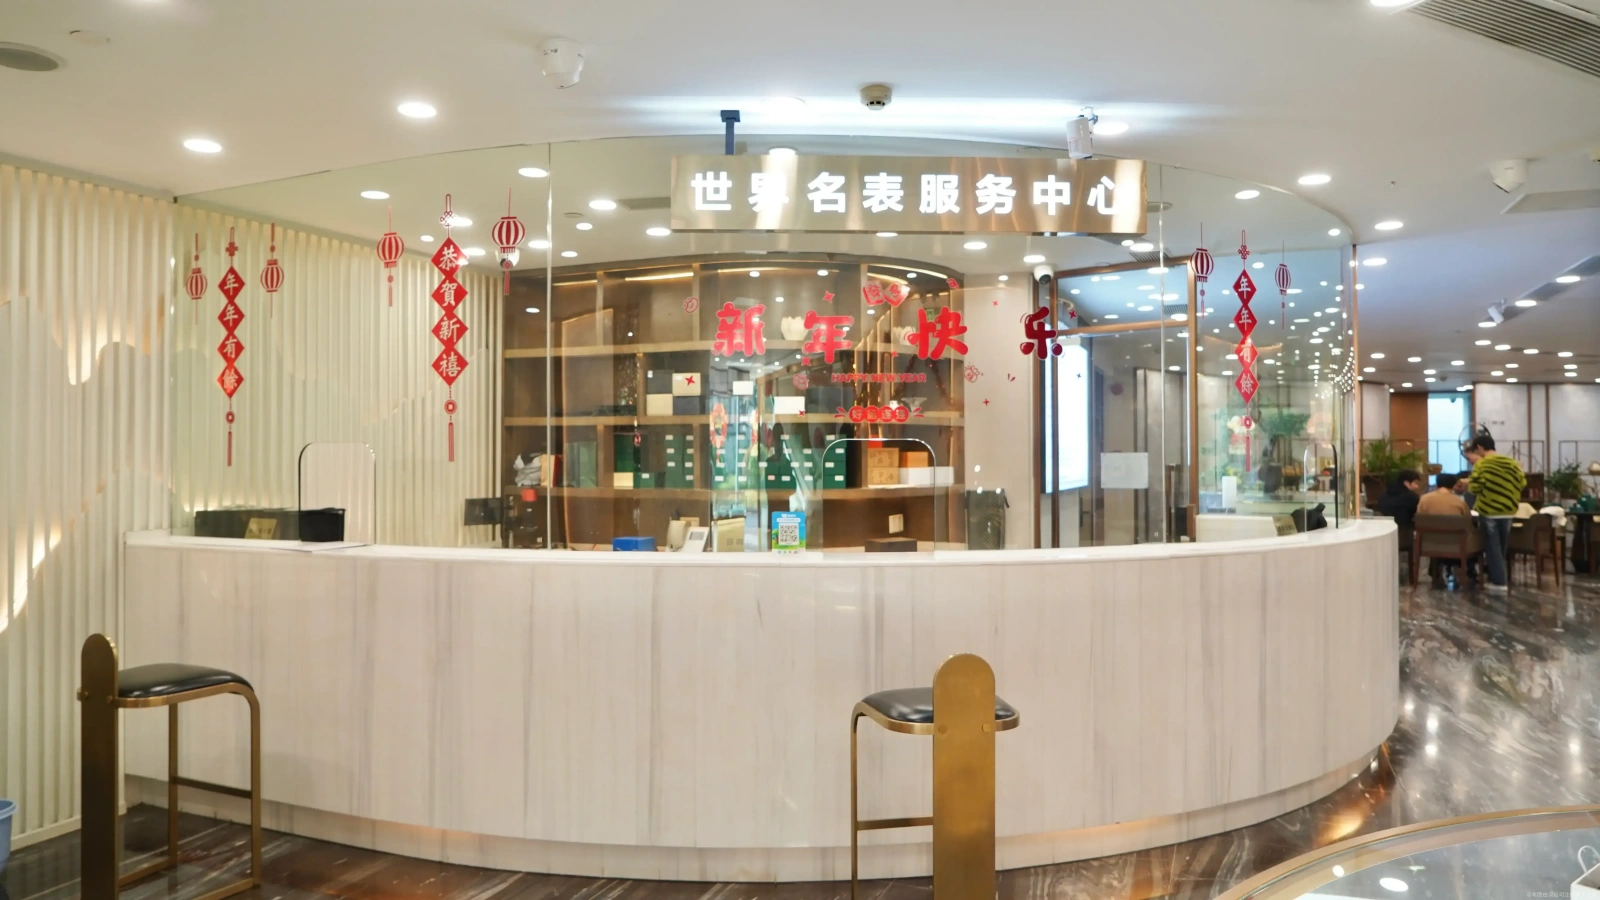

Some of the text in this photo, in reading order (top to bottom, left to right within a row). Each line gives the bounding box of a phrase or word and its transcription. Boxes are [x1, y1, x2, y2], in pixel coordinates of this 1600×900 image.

[691, 171, 1121, 216] 世界名表服务中心
[223, 274, 239, 389] 年年有餘
[439, 244, 461, 377] 恭賀新禧
[712, 302, 1063, 364] 新年快乐
[831, 373, 927, 383] HAPPY NEW YEAR
